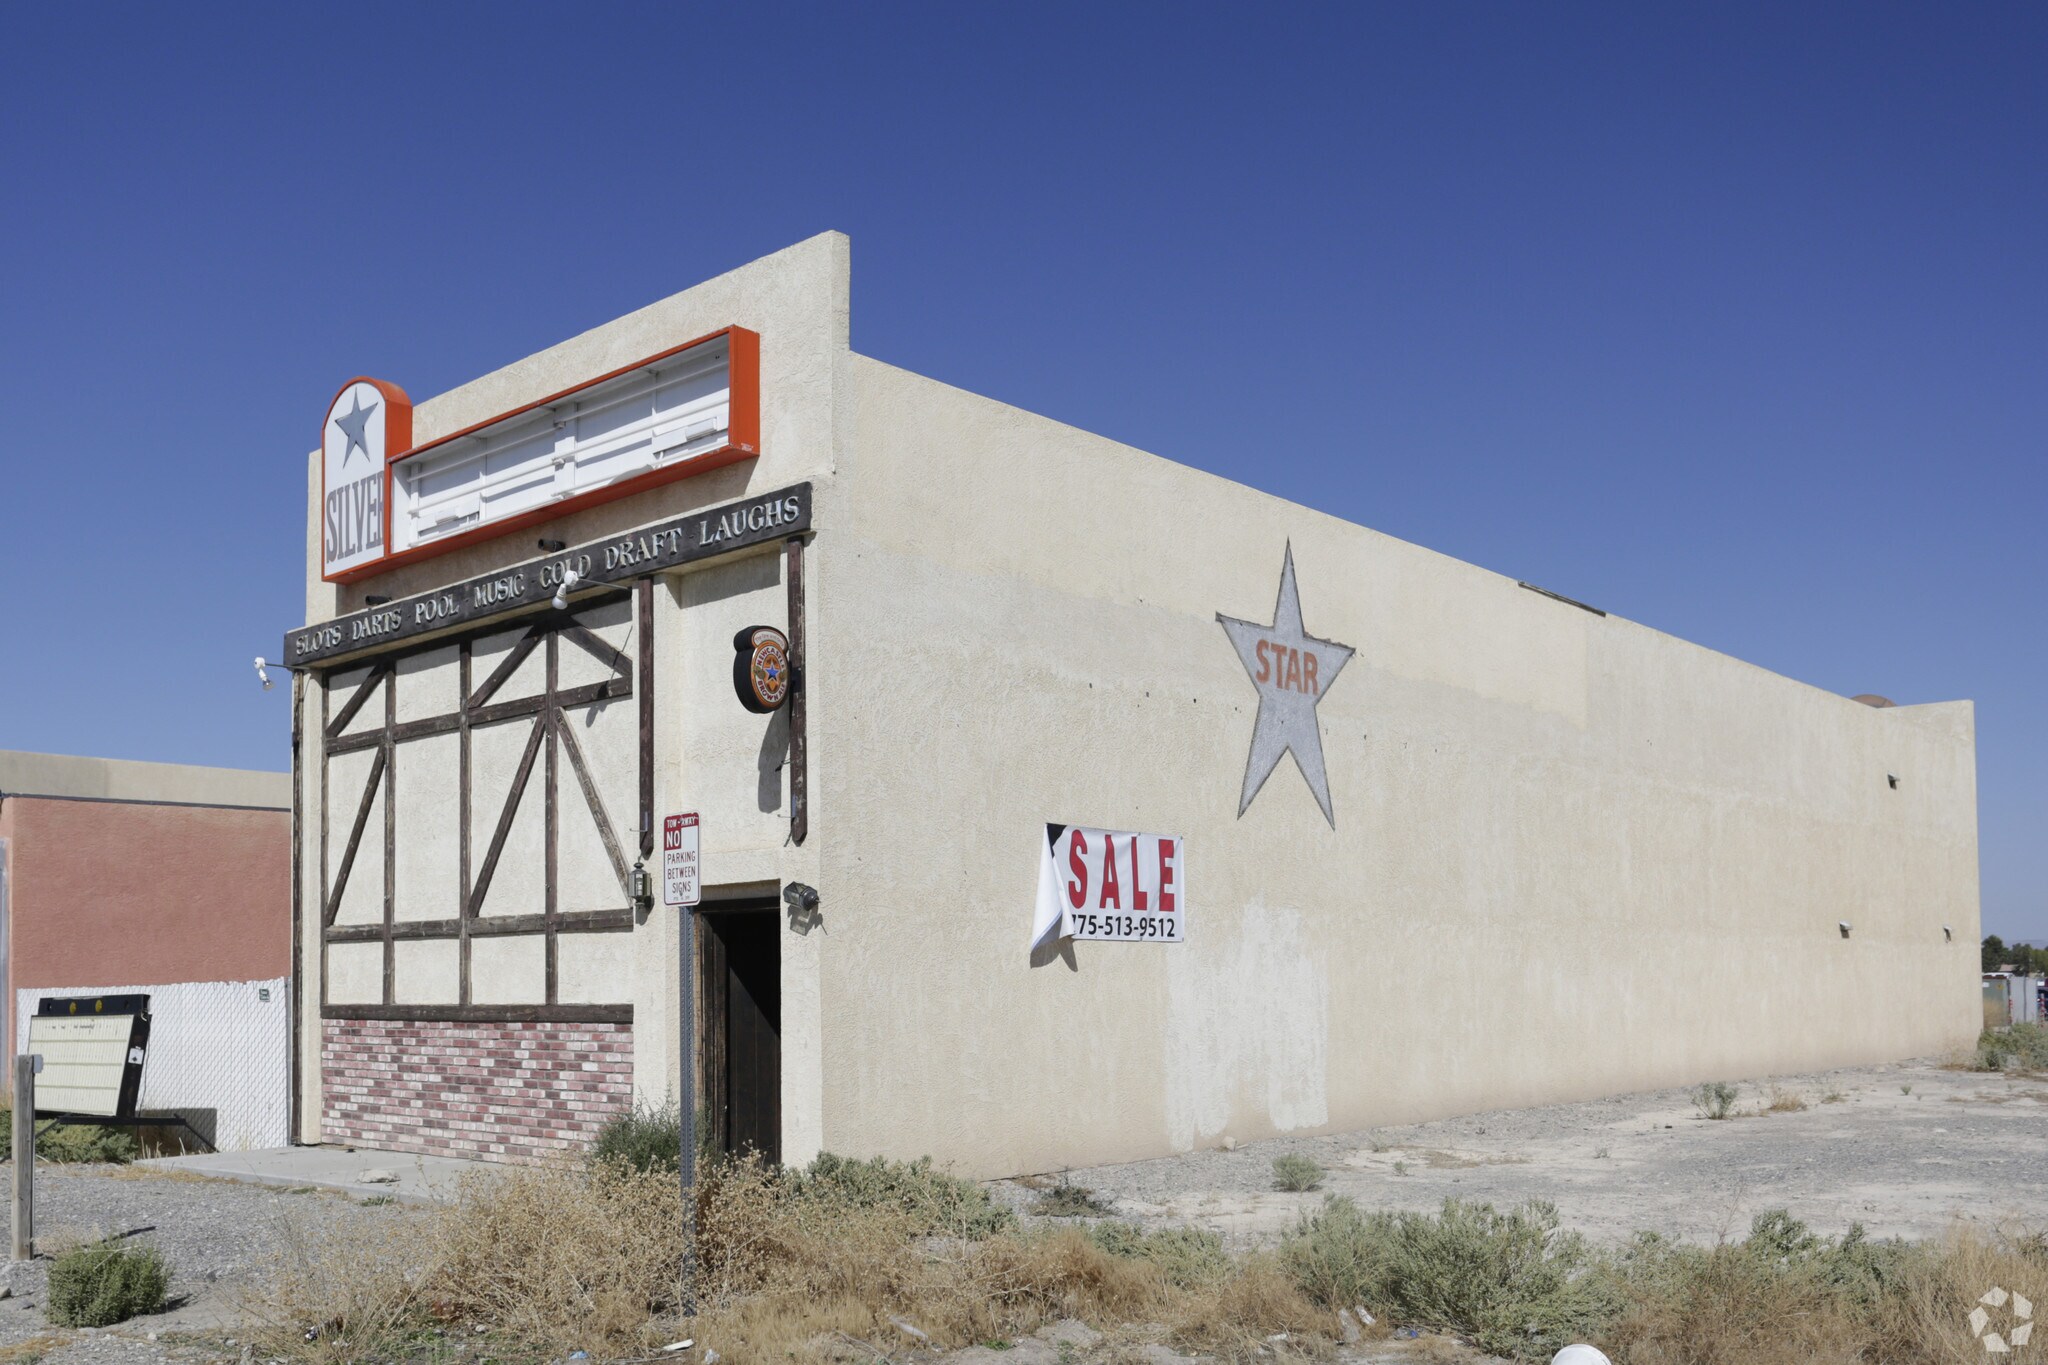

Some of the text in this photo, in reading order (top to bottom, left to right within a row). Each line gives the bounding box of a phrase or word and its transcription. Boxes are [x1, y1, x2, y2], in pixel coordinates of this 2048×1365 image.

[296, 626, 342, 655] SLOTS
[352, 609, 402, 640] DARTS
[415, 595, 459, 624] POOL
[474, 573, 525, 608] MUSIC
[604, 528, 682, 571] DRAFT
[700, 496, 799, 546] LAUGHS
[1256, 639, 1318, 695] STAR
[757, 680, 779, 700] BROWN
[667, 831, 680, 848] NO
[667, 851, 695, 865] PARKING
[668, 866, 696, 880] BETWEEN
[1068, 829, 1175, 912] SALE
[672, 881, 692, 894] SIGNS
